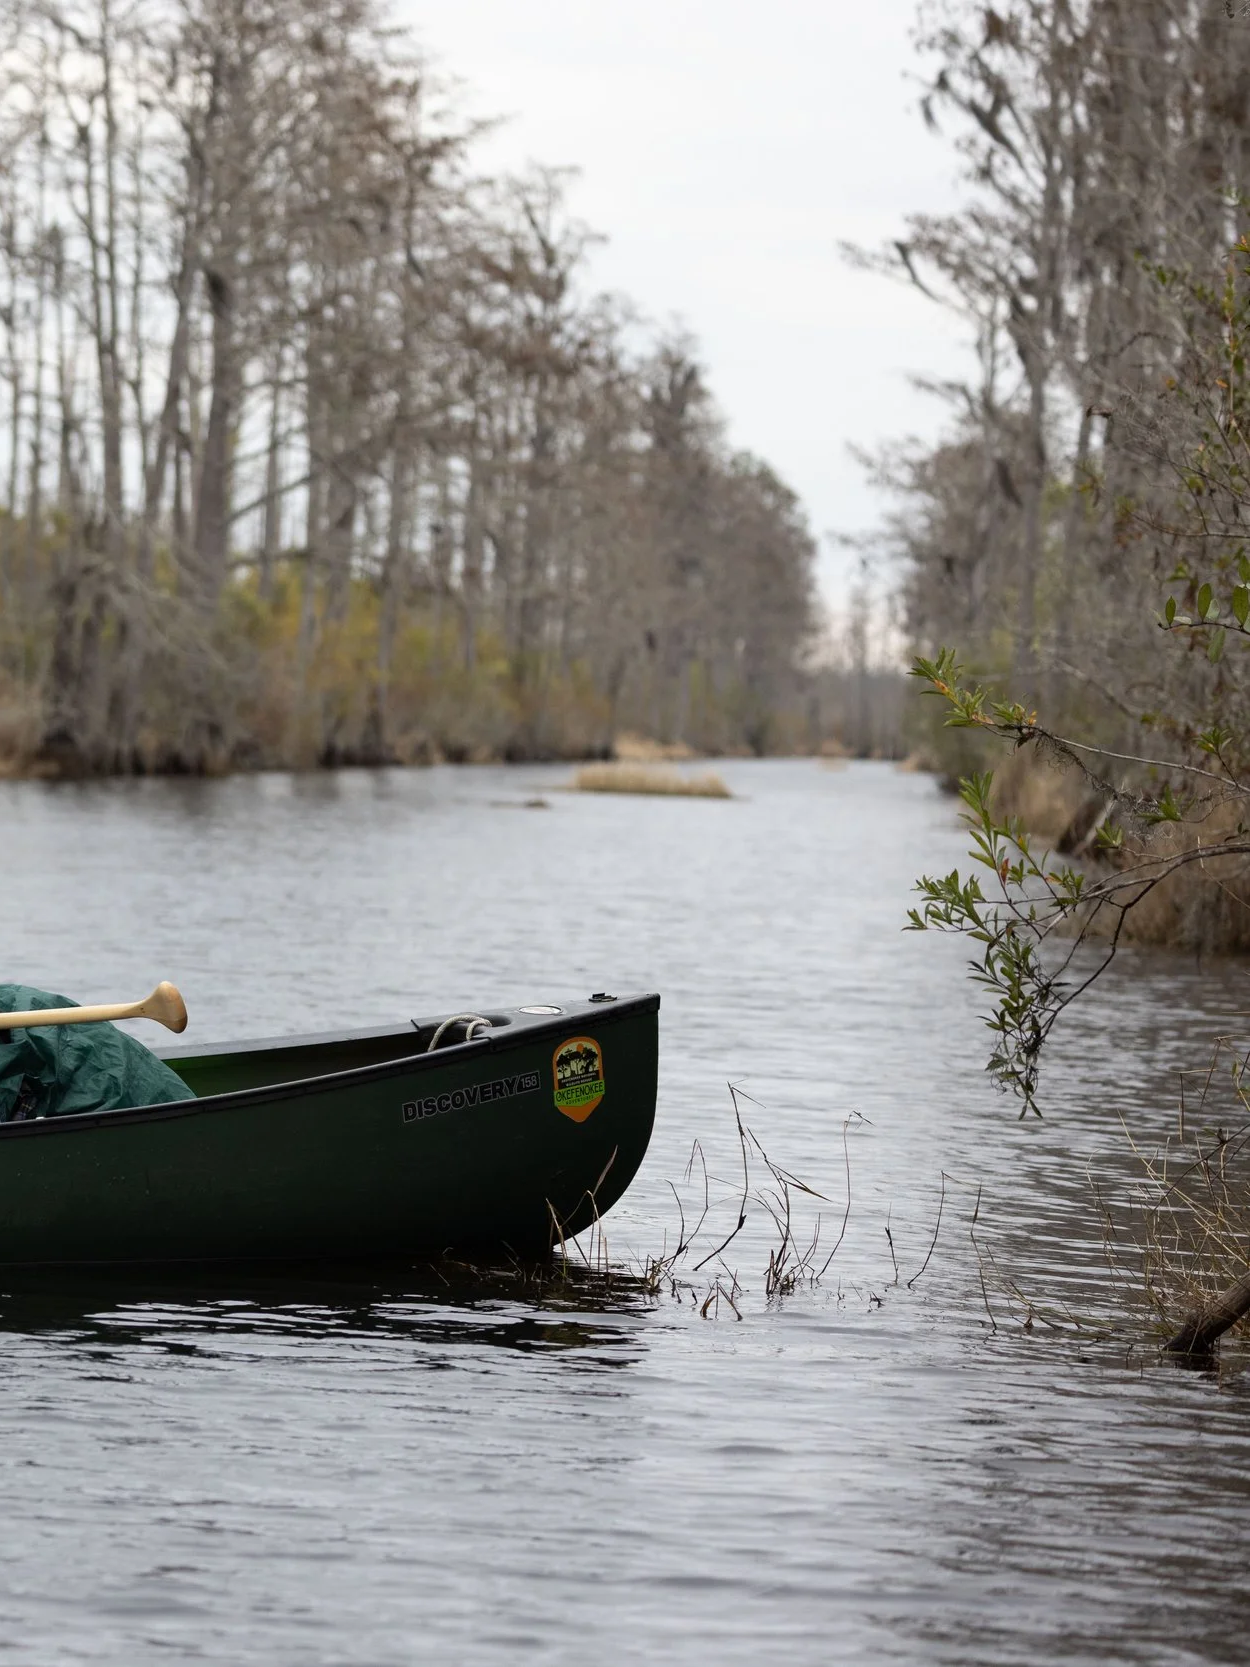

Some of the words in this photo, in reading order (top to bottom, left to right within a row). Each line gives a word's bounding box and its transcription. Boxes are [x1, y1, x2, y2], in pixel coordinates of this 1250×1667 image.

[402, 1075, 518, 1123] DISCOVERY
[520, 1075, 538, 1090] 158
[555, 1081, 604, 1102] OKEFENOKEE
